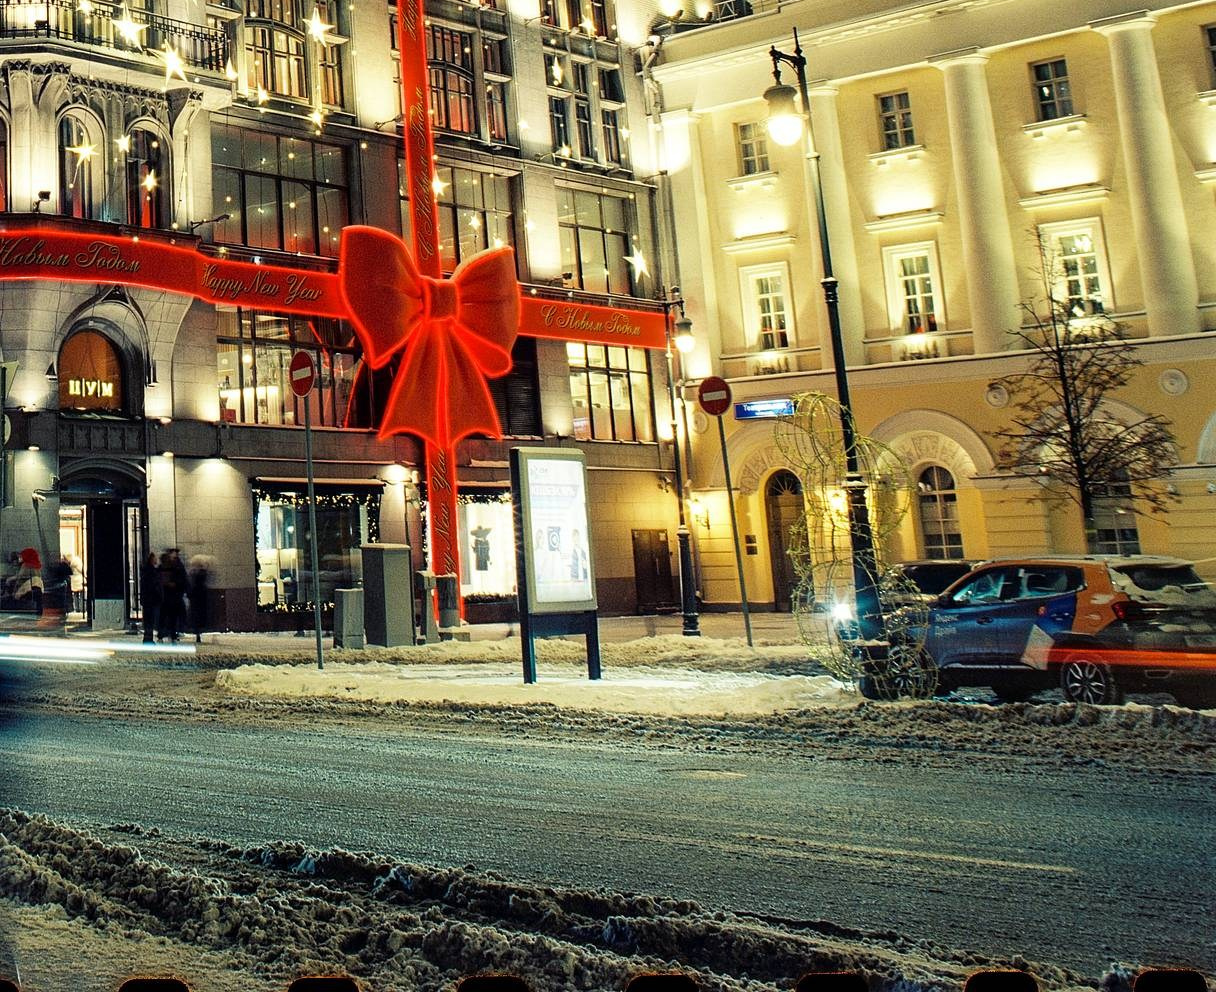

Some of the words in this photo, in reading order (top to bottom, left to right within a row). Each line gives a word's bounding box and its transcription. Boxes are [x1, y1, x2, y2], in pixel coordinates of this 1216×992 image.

[75, 240, 142, 273] Годом
[201, 262, 245, 300] Happy
[244, 270, 281, 297] New
[285, 273, 323, 305] Year
[540, 304, 558, 327] С
[556, 306, 604, 333] Новым
[604, 311, 641, 336] Годом
[430, 448, 452, 496] Yea
[434, 502, 450, 551] New
